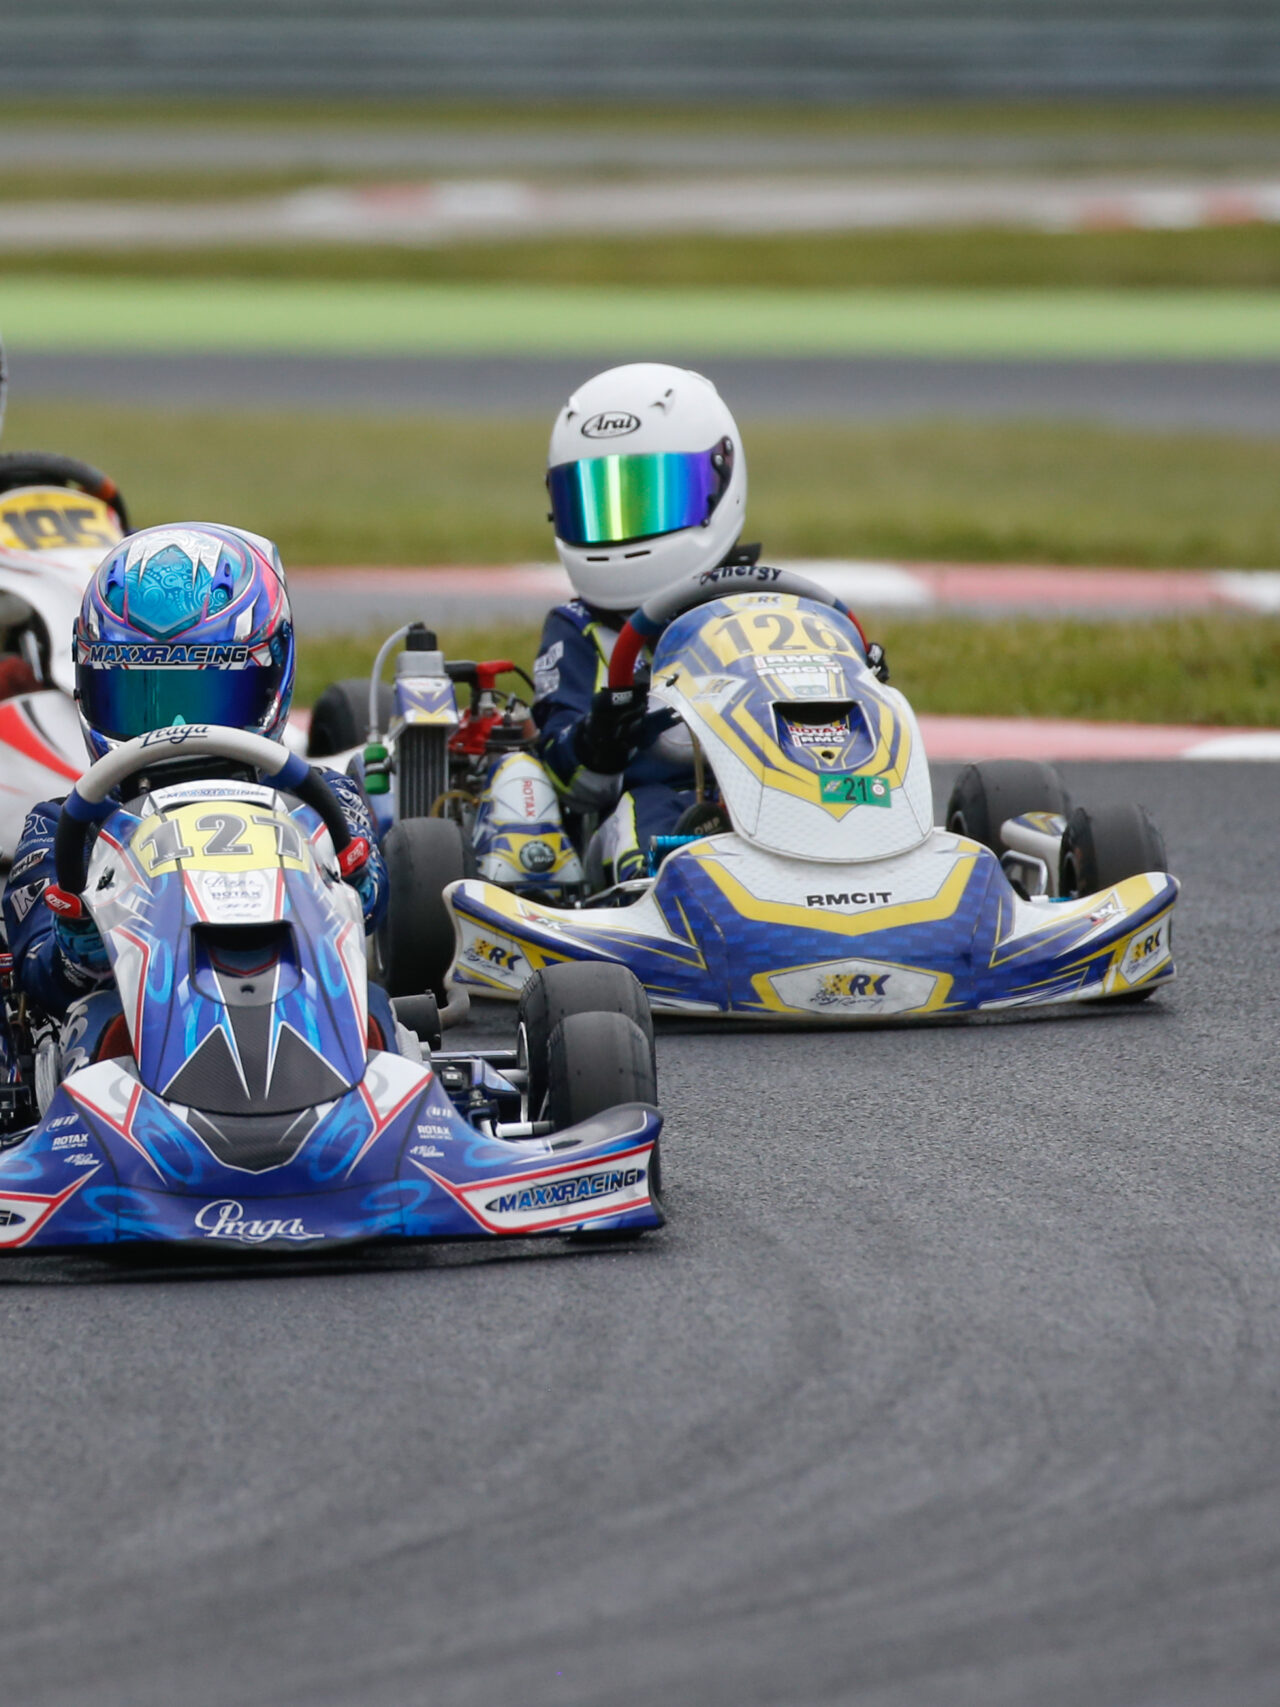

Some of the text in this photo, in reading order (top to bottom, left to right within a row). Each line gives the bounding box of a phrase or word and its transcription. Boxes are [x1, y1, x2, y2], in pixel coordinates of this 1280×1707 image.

[592, 413, 634, 432] Arai
[716, 613, 850, 656] 126
[90, 645, 249, 664] MAXXRACING
[788, 724, 847, 735] ROTAX
[522, 779, 537, 818] ROTAX
[843, 776, 868, 803] 21
[138, 811, 303, 870] 127
[806, 892, 892, 907] RMCIT
[52, 1133, 89, 1145] ROTAX
[498, 1169, 637, 1213] MAXXRACING
[194, 1199, 325, 1244] Praga
